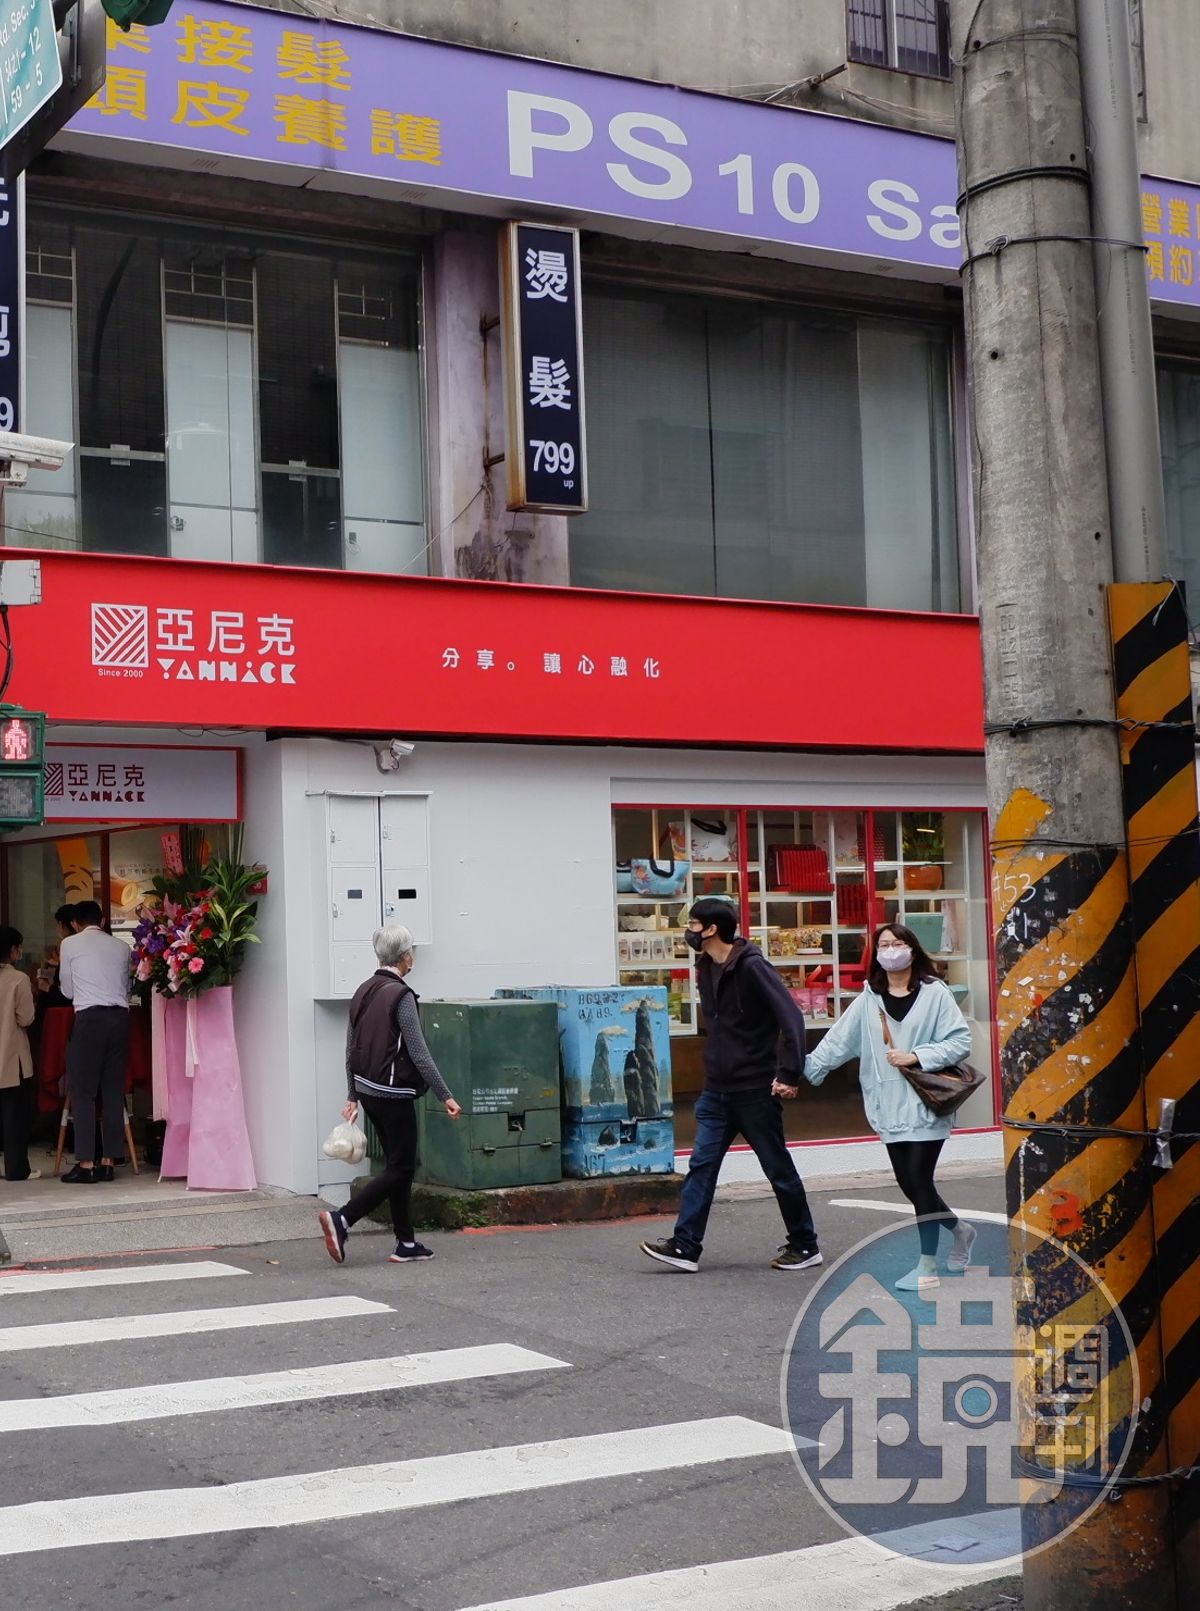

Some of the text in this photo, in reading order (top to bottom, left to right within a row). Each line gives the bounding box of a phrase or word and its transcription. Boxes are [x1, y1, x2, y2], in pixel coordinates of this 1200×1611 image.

[10, 9, 29, 33] Sec.
[28, 27, 42, 55] 12
[10, 85, 23, 113] 59
[35, 62, 43, 86] 5
[506, 89, 693, 202] PS
[718, 153, 820, 224] 10
[525, 247, 572, 410] 燙髮
[529, 439, 575, 475] 799
[563, 479, 574, 489] up
[155, 607, 296, 656] 亞尼克
[98, 668, 144, 678] Since 2000
[156, 658, 297, 684] YANNICK
[67, 763, 145, 787] 亞尼克
[68, 790, 145, 802] YANNICK
